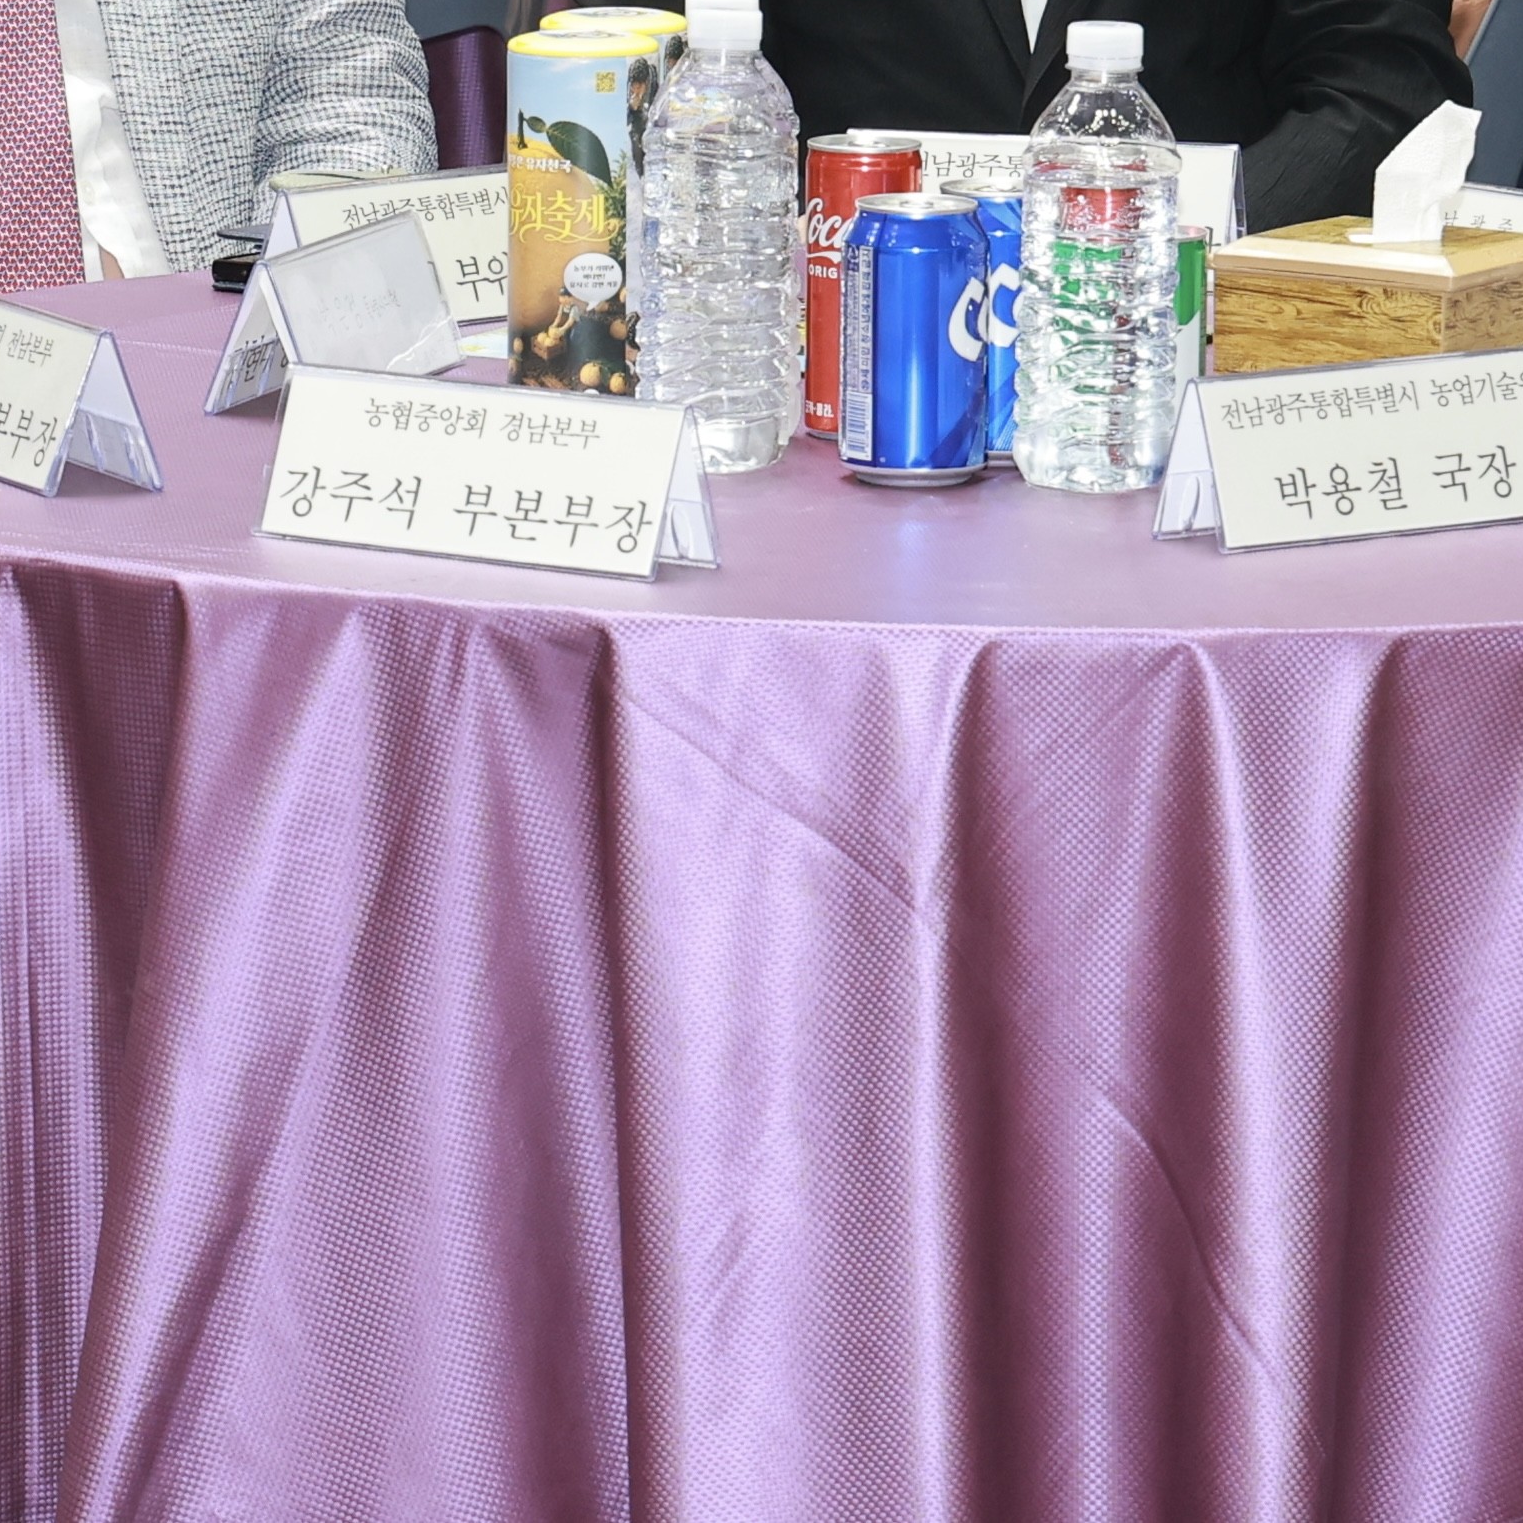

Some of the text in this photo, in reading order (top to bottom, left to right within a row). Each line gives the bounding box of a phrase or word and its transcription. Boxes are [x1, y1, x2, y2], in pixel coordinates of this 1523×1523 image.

[7, 328, 55, 367] 전남본부
[365, 397, 601, 450] 농협중앙회 경남본부
[1220, 380, 1421, 431] 전남광주통합특별시
[1274, 444, 1518, 520] 박용철 국장
[279, 465, 654, 555] 강주석 부본부장
